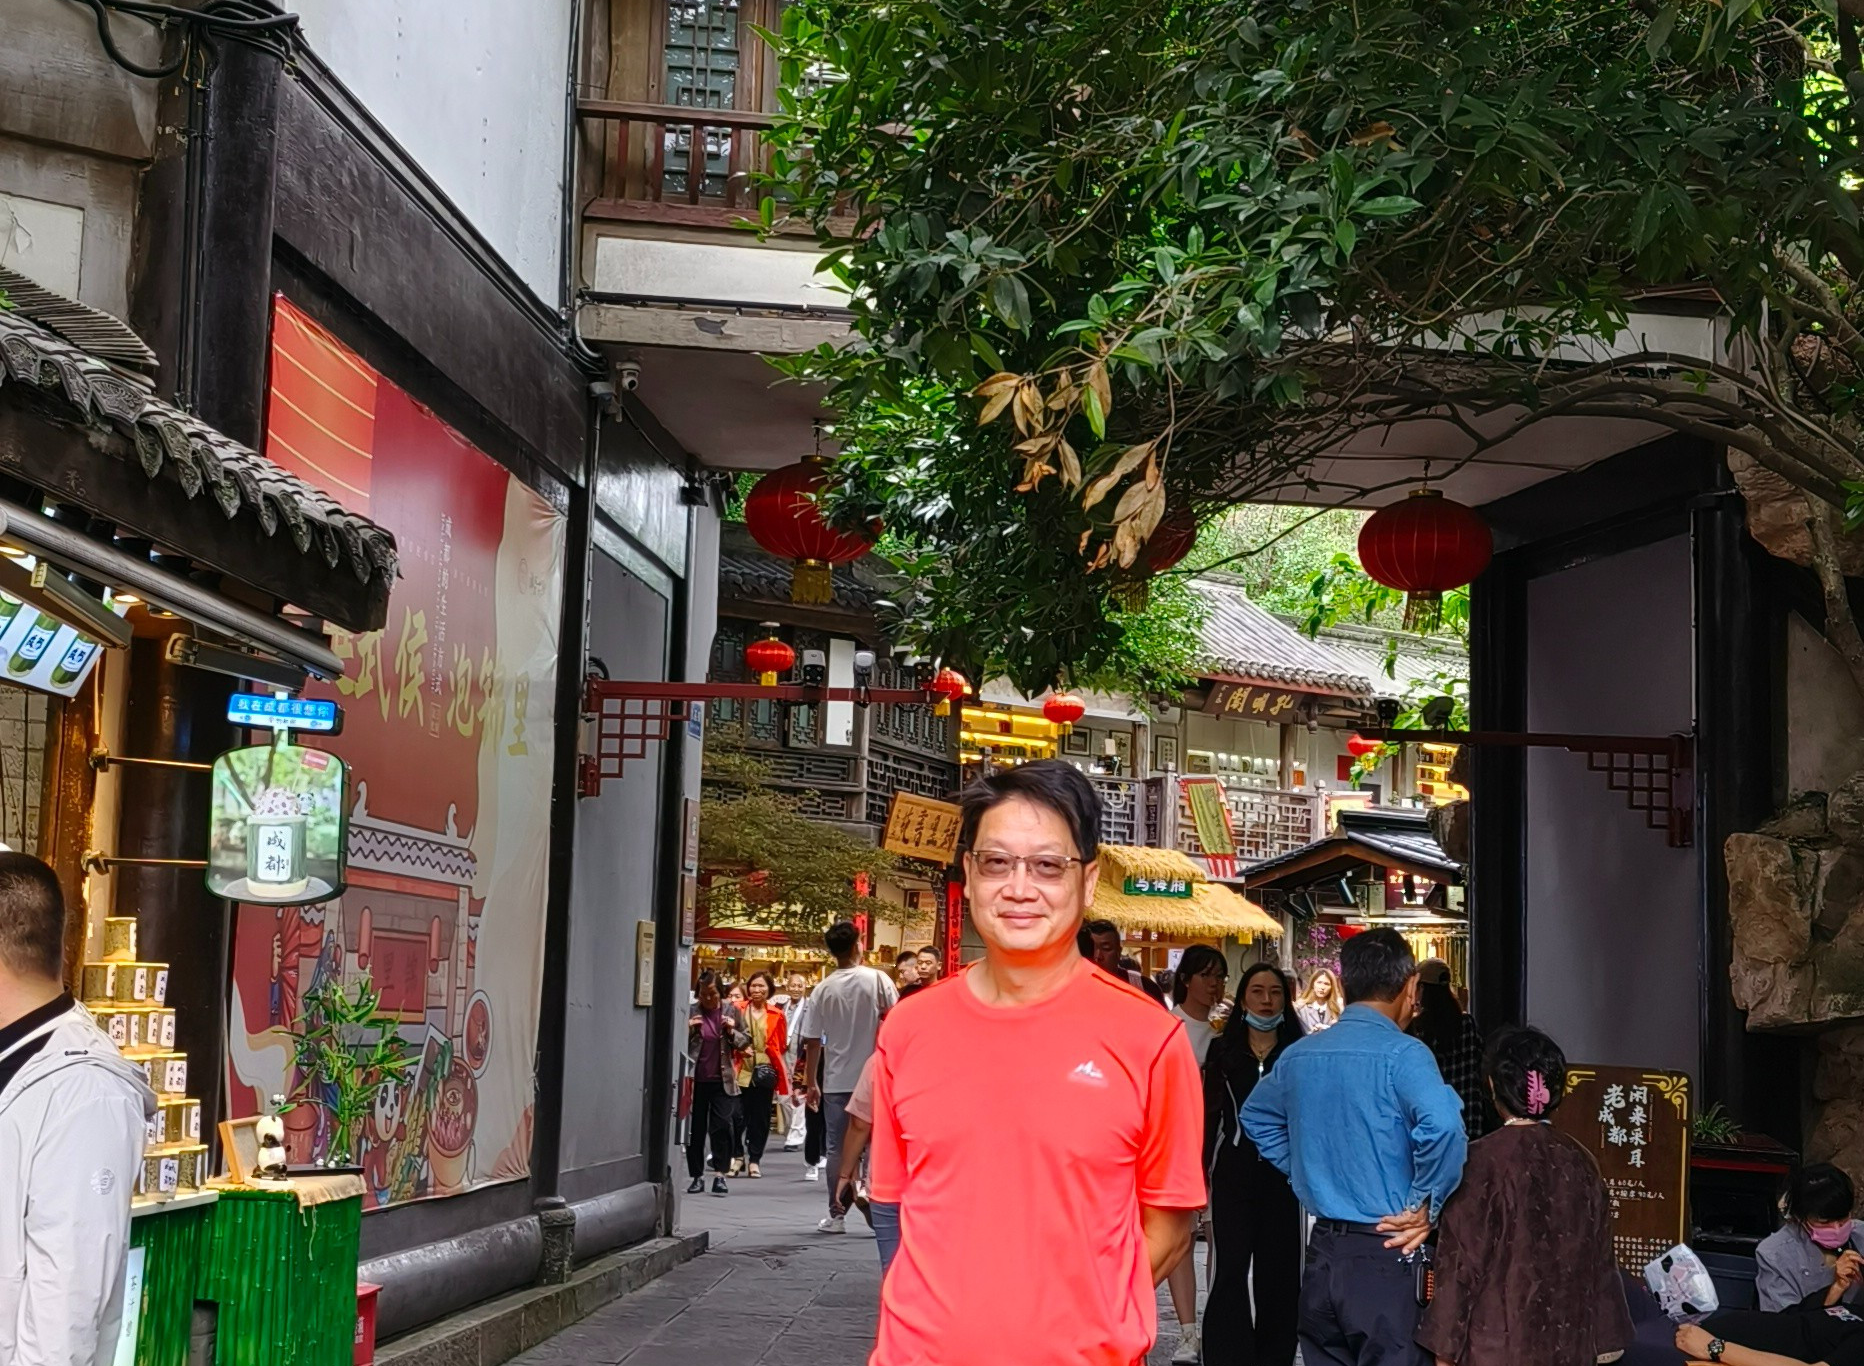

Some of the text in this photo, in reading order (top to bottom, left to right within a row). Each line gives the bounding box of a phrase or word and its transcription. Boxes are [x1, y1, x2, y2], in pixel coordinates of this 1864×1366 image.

[237, 698, 329, 718] 我在成都很想你
[1598, 1083, 1628, 1146] 老成都
[1628, 1084, 1648, 1168] 闲来采耳
